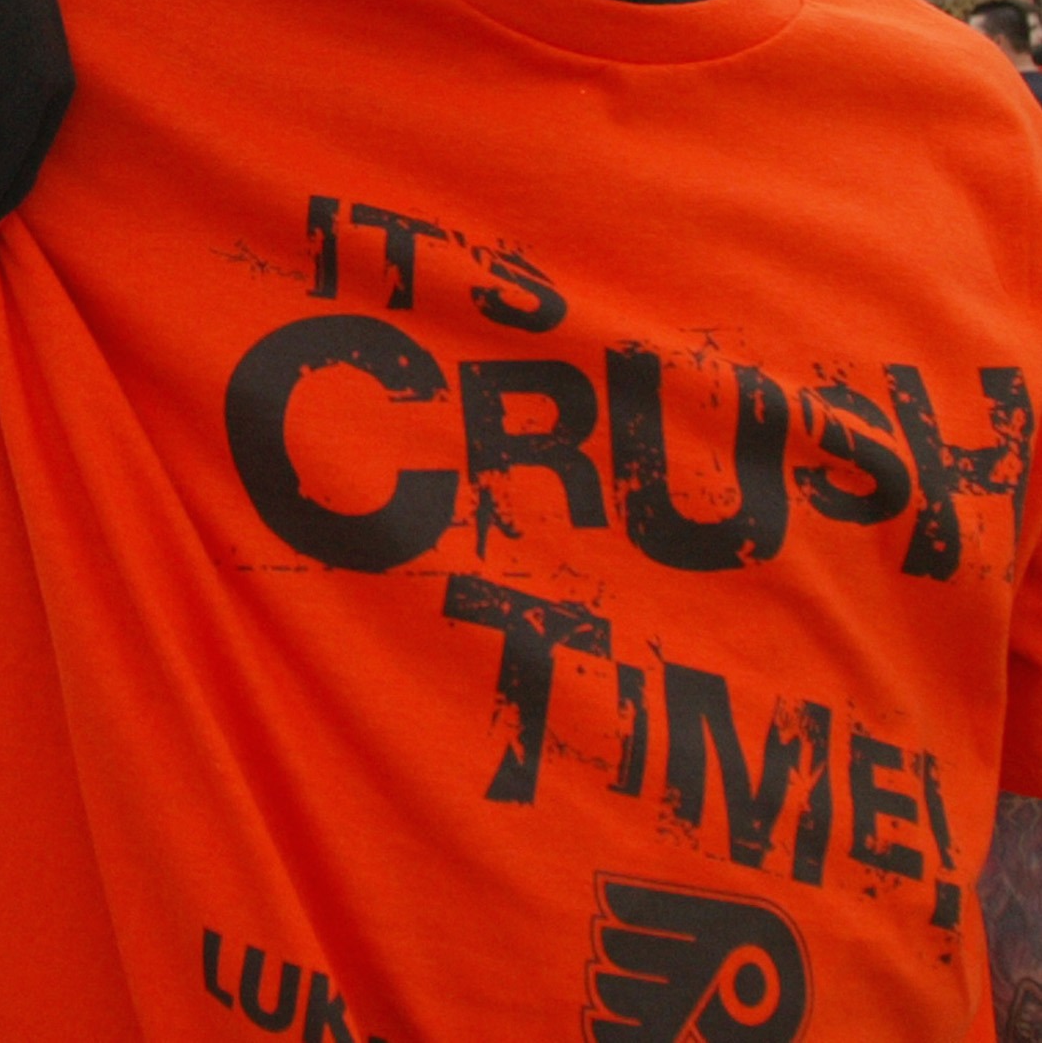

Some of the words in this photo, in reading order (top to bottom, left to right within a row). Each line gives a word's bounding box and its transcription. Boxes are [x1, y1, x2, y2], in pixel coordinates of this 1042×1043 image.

[307, 194, 568, 333] IT'S
[224, 313, 1035, 583] CRUSH
[442, 571, 962, 933] TIME!
[202, 927, 390, 1043] LUK
